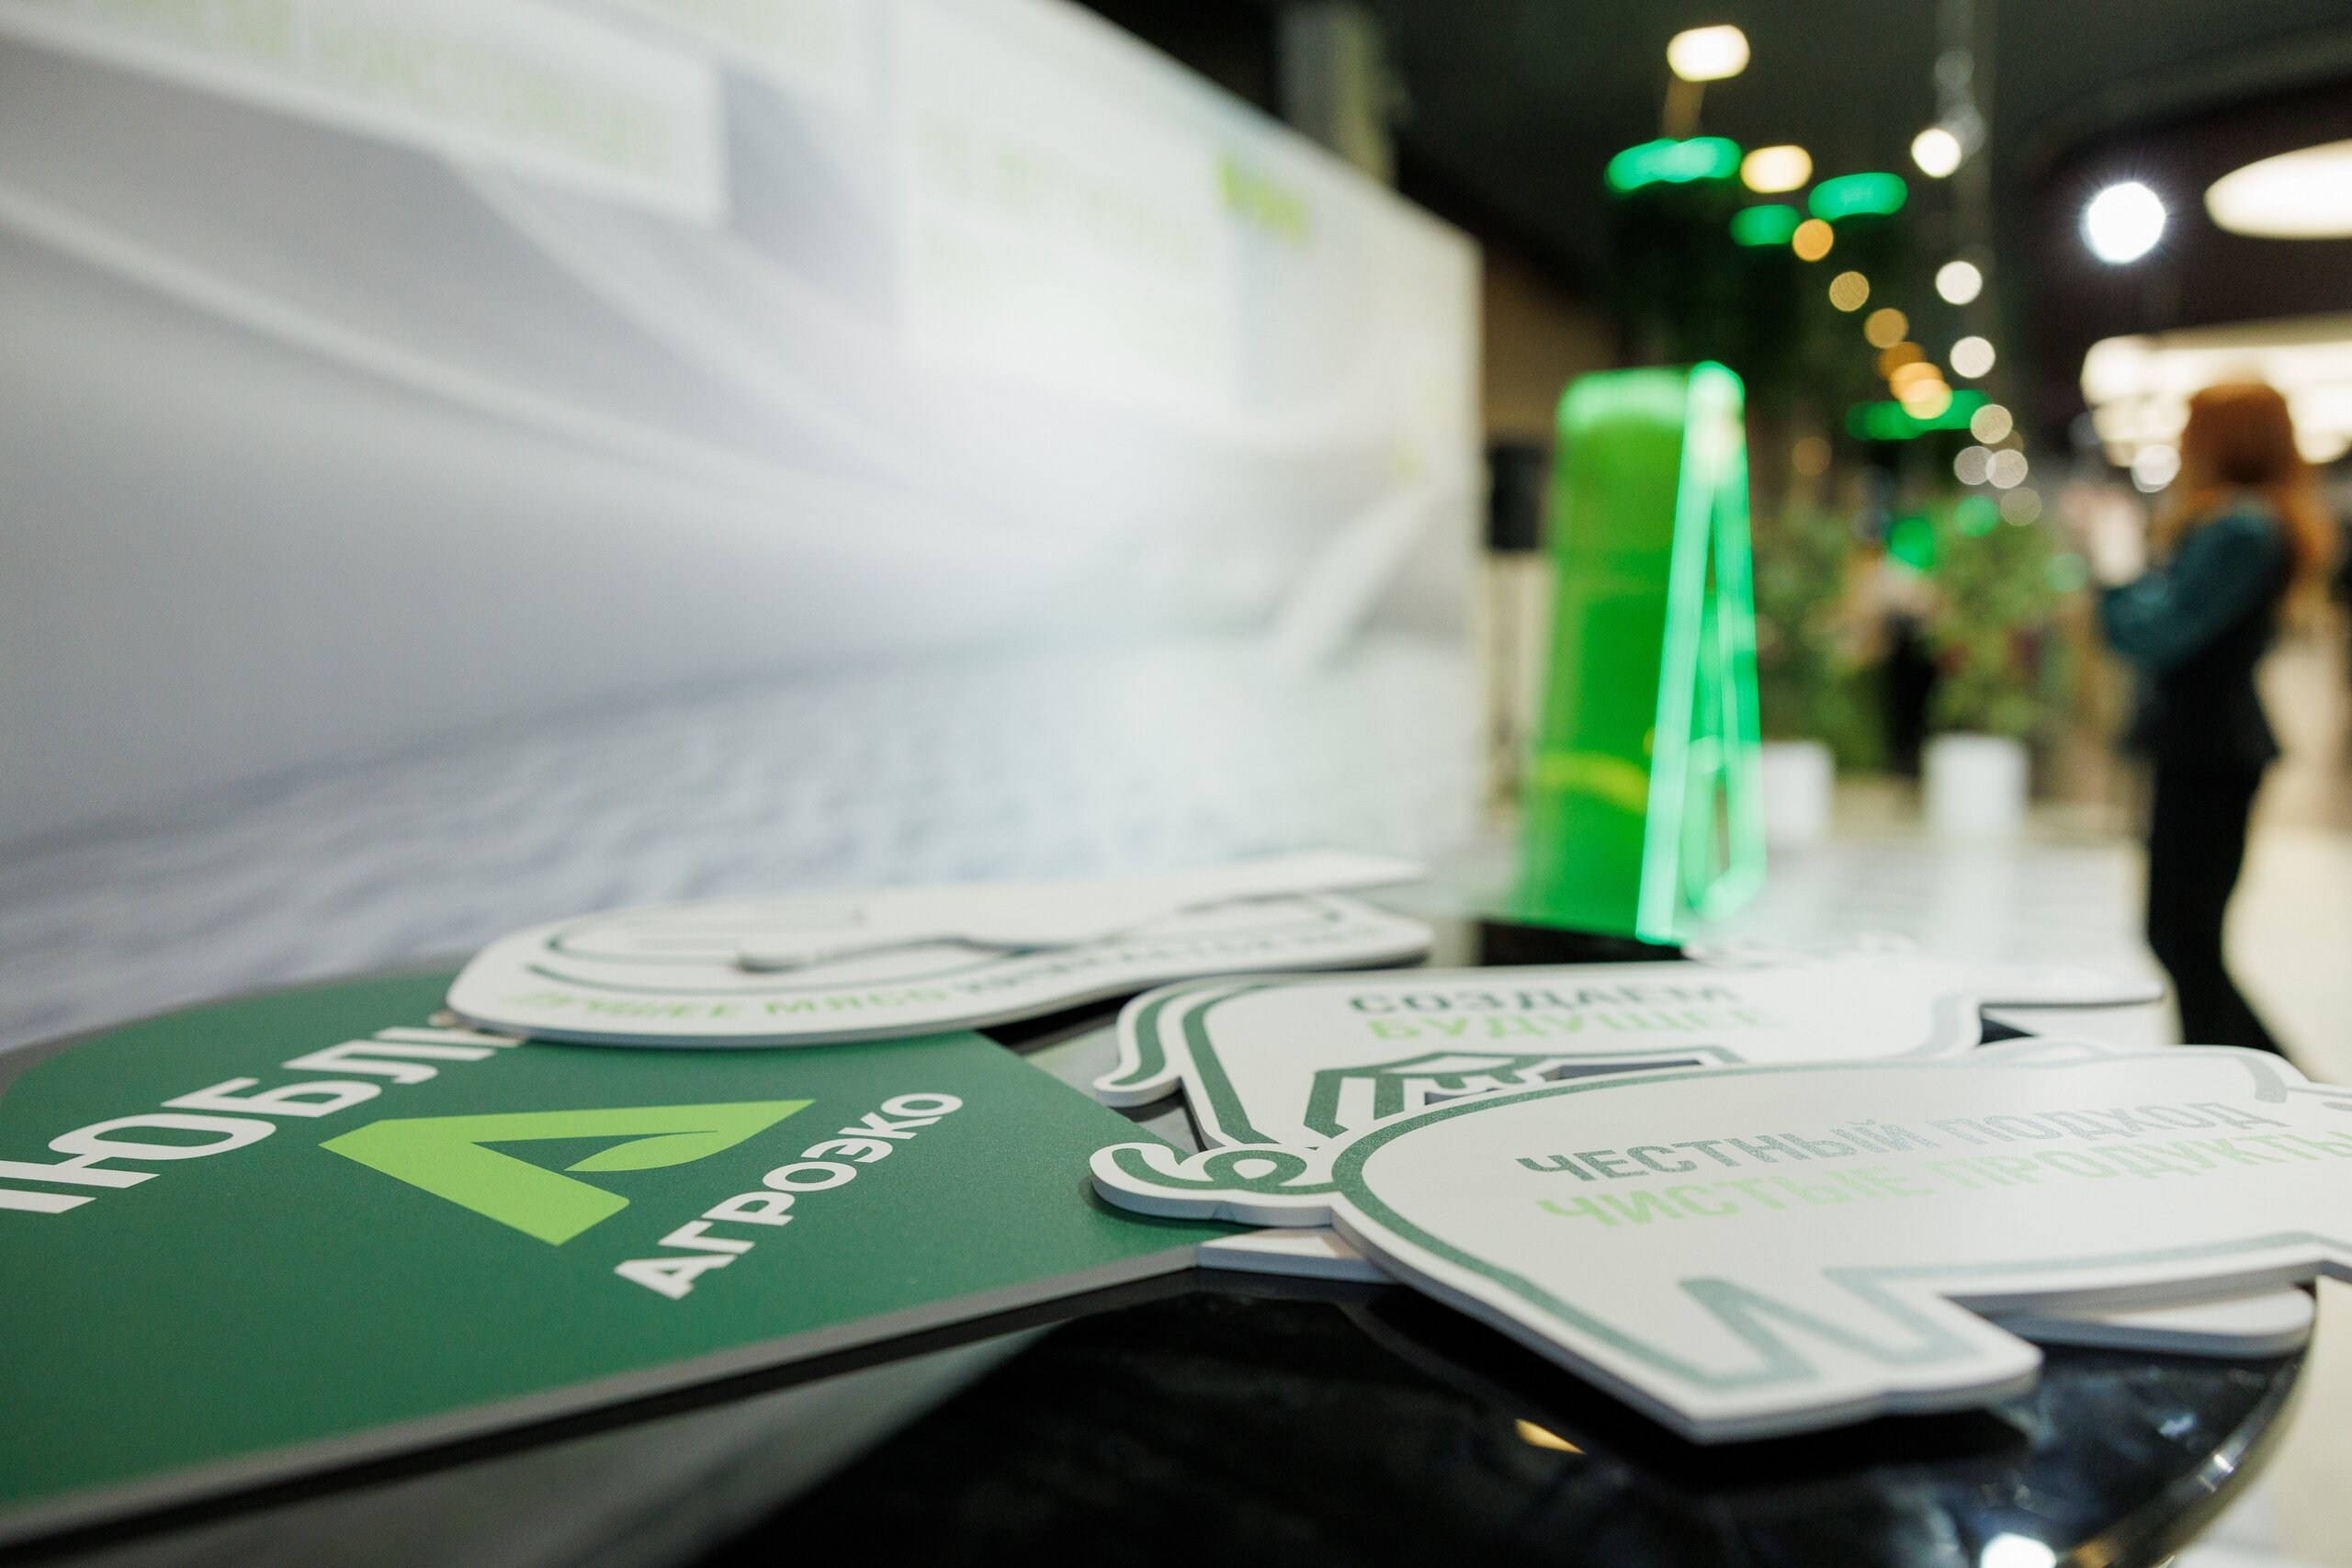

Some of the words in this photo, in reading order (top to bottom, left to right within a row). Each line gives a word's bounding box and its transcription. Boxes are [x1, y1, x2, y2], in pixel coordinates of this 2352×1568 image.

[763, 987, 952, 1015] МЯСО
[1349, 983, 1744, 1012] СОЗДАЕМ
[1515, 1119, 1940, 1181] ЧЕСТНЫЙ
[1926, 1102, 2290, 1146] ПОДХОД
[1534, 1165, 1938, 1228] ЧИСТЫЕ
[1923, 1131, 2352, 1190] ПРОДУКТЫ
[614, 1093, 964, 1301] АГРОЭКО
